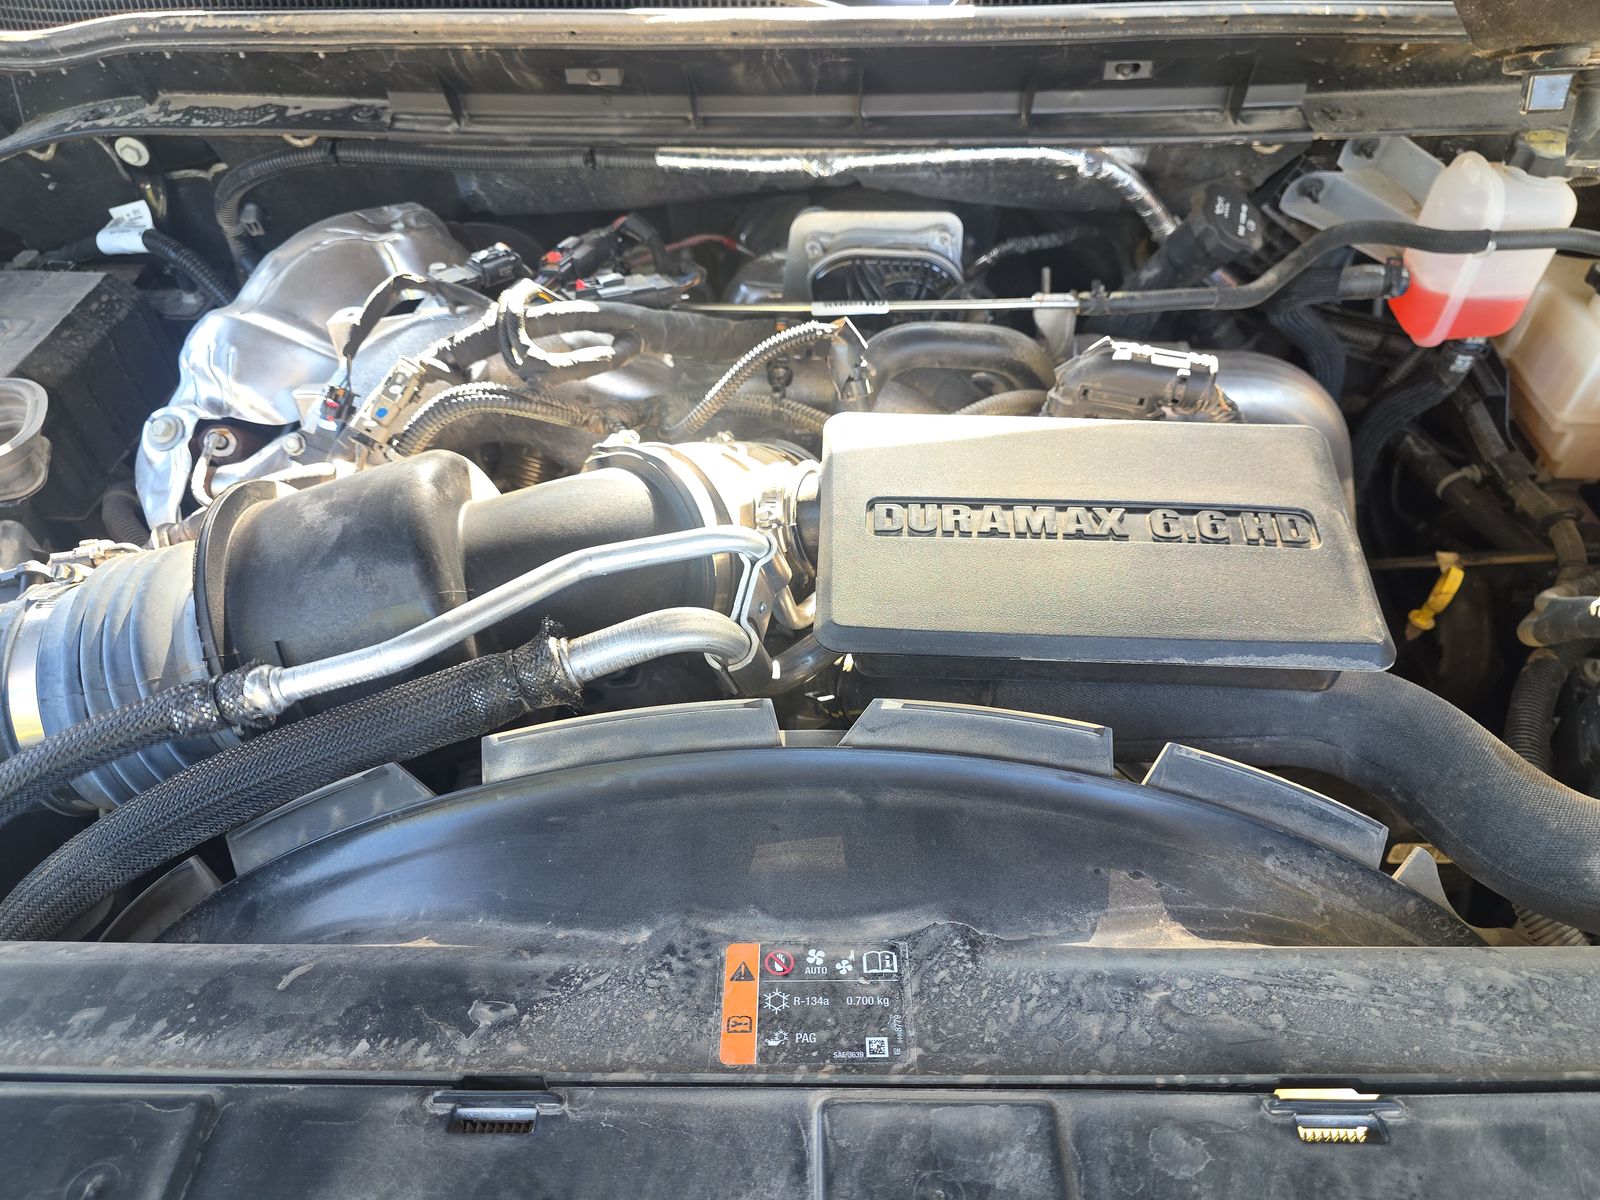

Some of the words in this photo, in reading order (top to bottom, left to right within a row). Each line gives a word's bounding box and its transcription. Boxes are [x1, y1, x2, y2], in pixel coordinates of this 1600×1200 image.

[873, 503, 1130, 541] DURAMAX
[1149, 508, 1230, 545] 6.6
[1240, 512, 1311, 548] HD
[804, 966, 828, 975] AUTO
[793, 996, 830, 1006] R-134a
[846, 996, 875, 1006] 0.700
[877, 995, 890, 1007] kg
[795, 1032, 817, 1044] PAG
